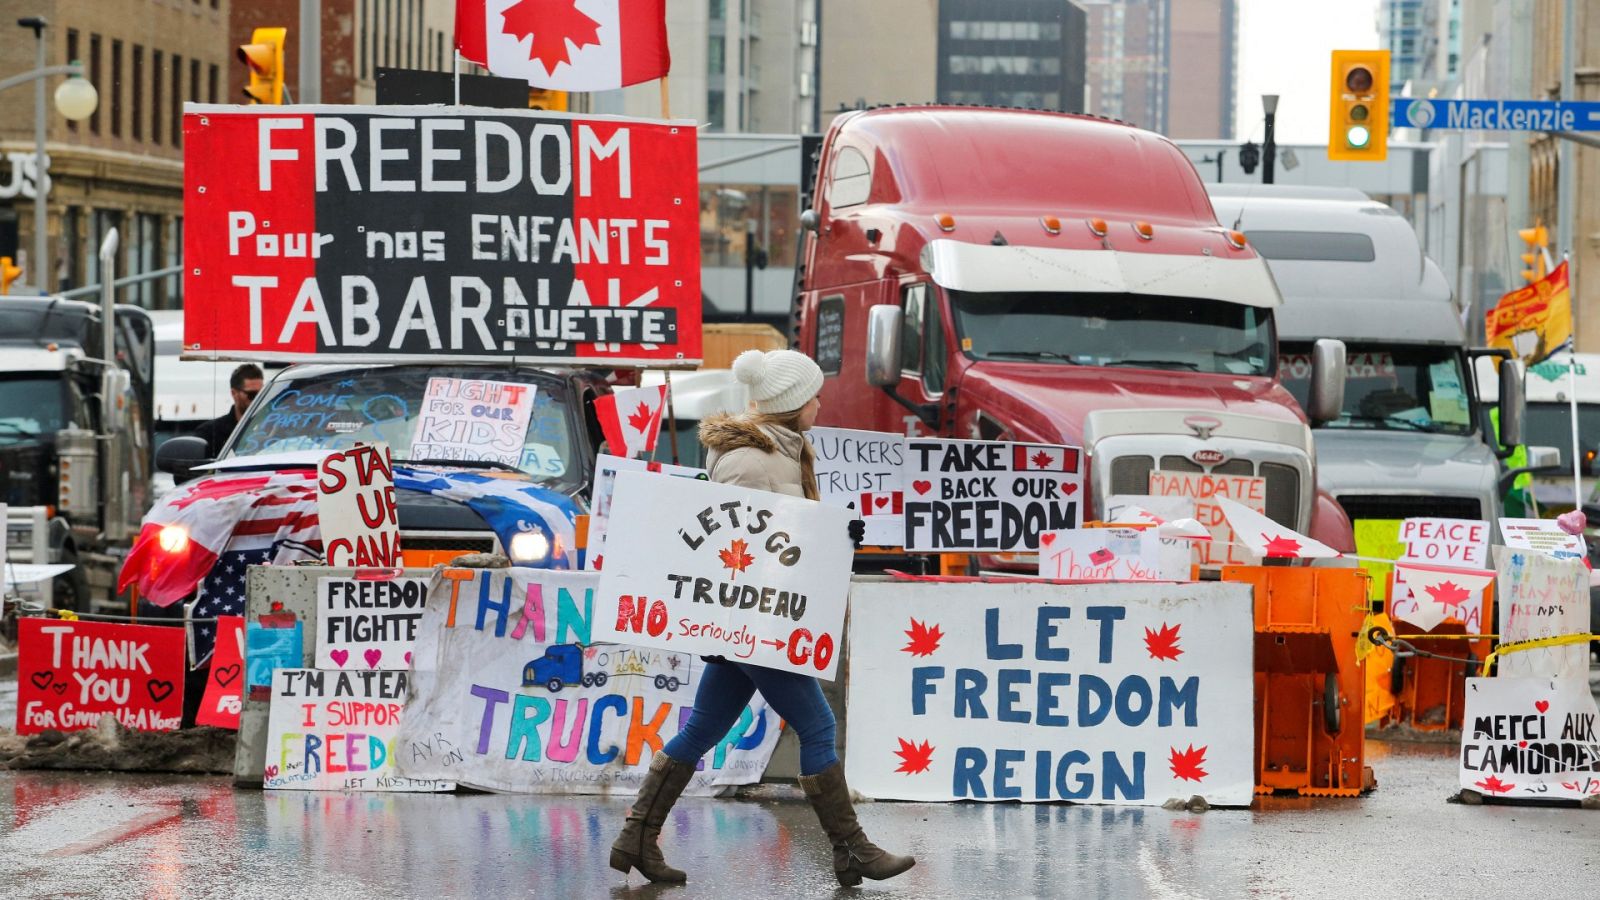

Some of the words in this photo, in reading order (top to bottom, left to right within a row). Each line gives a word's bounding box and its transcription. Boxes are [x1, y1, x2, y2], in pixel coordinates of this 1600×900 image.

[1448, 101, 1575, 130] Mackenzie
[258, 116, 632, 199] FREEDOM
[228, 210, 334, 259] Pour
[366, 230, 446, 262] nos
[470, 213, 670, 266] ENFANTS
[271, 389, 355, 411] COME
[428, 377, 528, 405] FIGHT
[260, 411, 337, 430] PARTY
[430, 399, 465, 416] FOR
[471, 404, 514, 421] OUR
[421, 416, 525, 452] KIDS
[909, 443, 1007, 472] TAKE
[941, 477, 998, 500] BACK
[1012, 477, 1061, 500] OUR
[1150, 475, 1264, 500] MANDATE
[677, 500, 774, 551] LET'S
[764, 531, 802, 567] GO
[905, 500, 1077, 550] FREEDOM
[667, 573, 807, 622] TRUDEAU
[615, 594, 673, 641] NO,
[679, 617, 757, 659] Seriously
[786, 627, 834, 671] GO
[985, 605, 1126, 664] LET
[41, 626, 152, 675] THANK
[598, 648, 662, 667] OTTAWA
[72, 671, 130, 705] YOU
[281, 671, 324, 697] I'M
[334, 672, 354, 697] A
[911, 666, 1200, 728] FREEDOM
[59, 702, 114, 728] GIVI
[302, 703, 317, 727] I
[326, 701, 406, 727] SUPPOR
[1560, 712, 1598, 743] AUX
[412, 732, 452, 763] AYR
[442, 747, 464, 767] ON
[344, 778, 366, 790] LET
[952, 746, 1146, 801] REIGN
